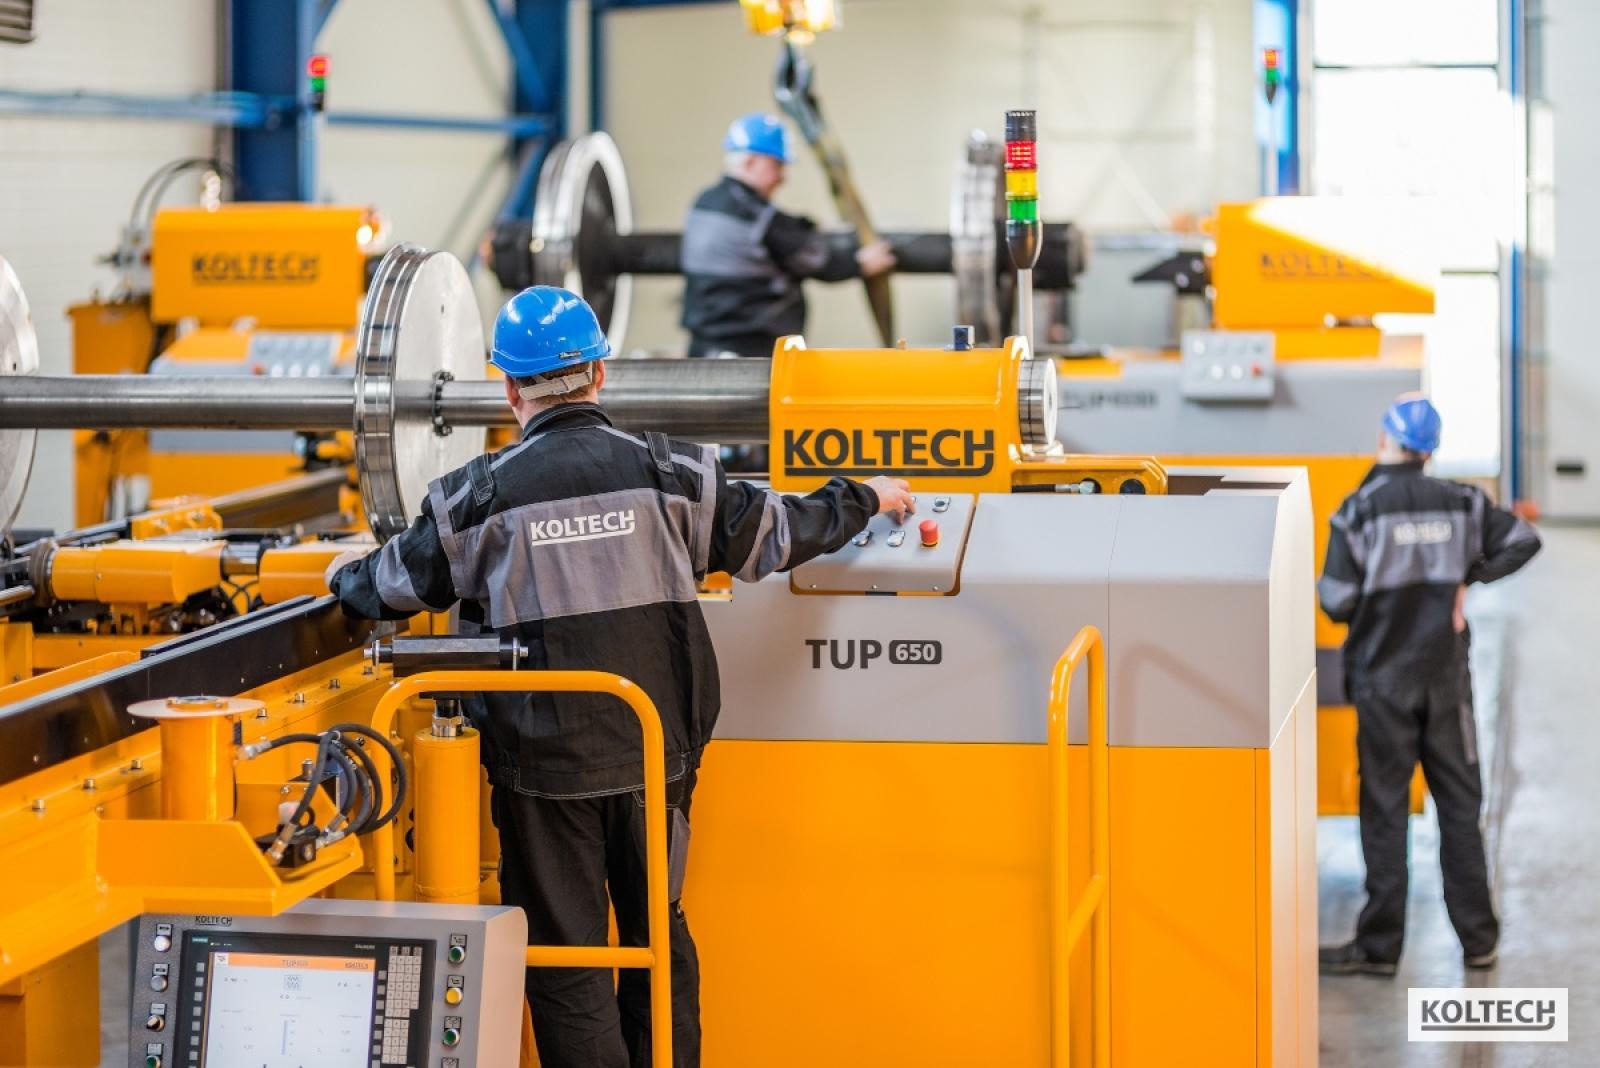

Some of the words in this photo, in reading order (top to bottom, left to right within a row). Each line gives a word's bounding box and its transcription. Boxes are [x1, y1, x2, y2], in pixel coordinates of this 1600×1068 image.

[784, 428, 994, 476] KOLTECH
[530, 509, 635, 546] KOLTECH
[805, 639, 882, 669] TUP
[895, 643, 936, 661] 650
